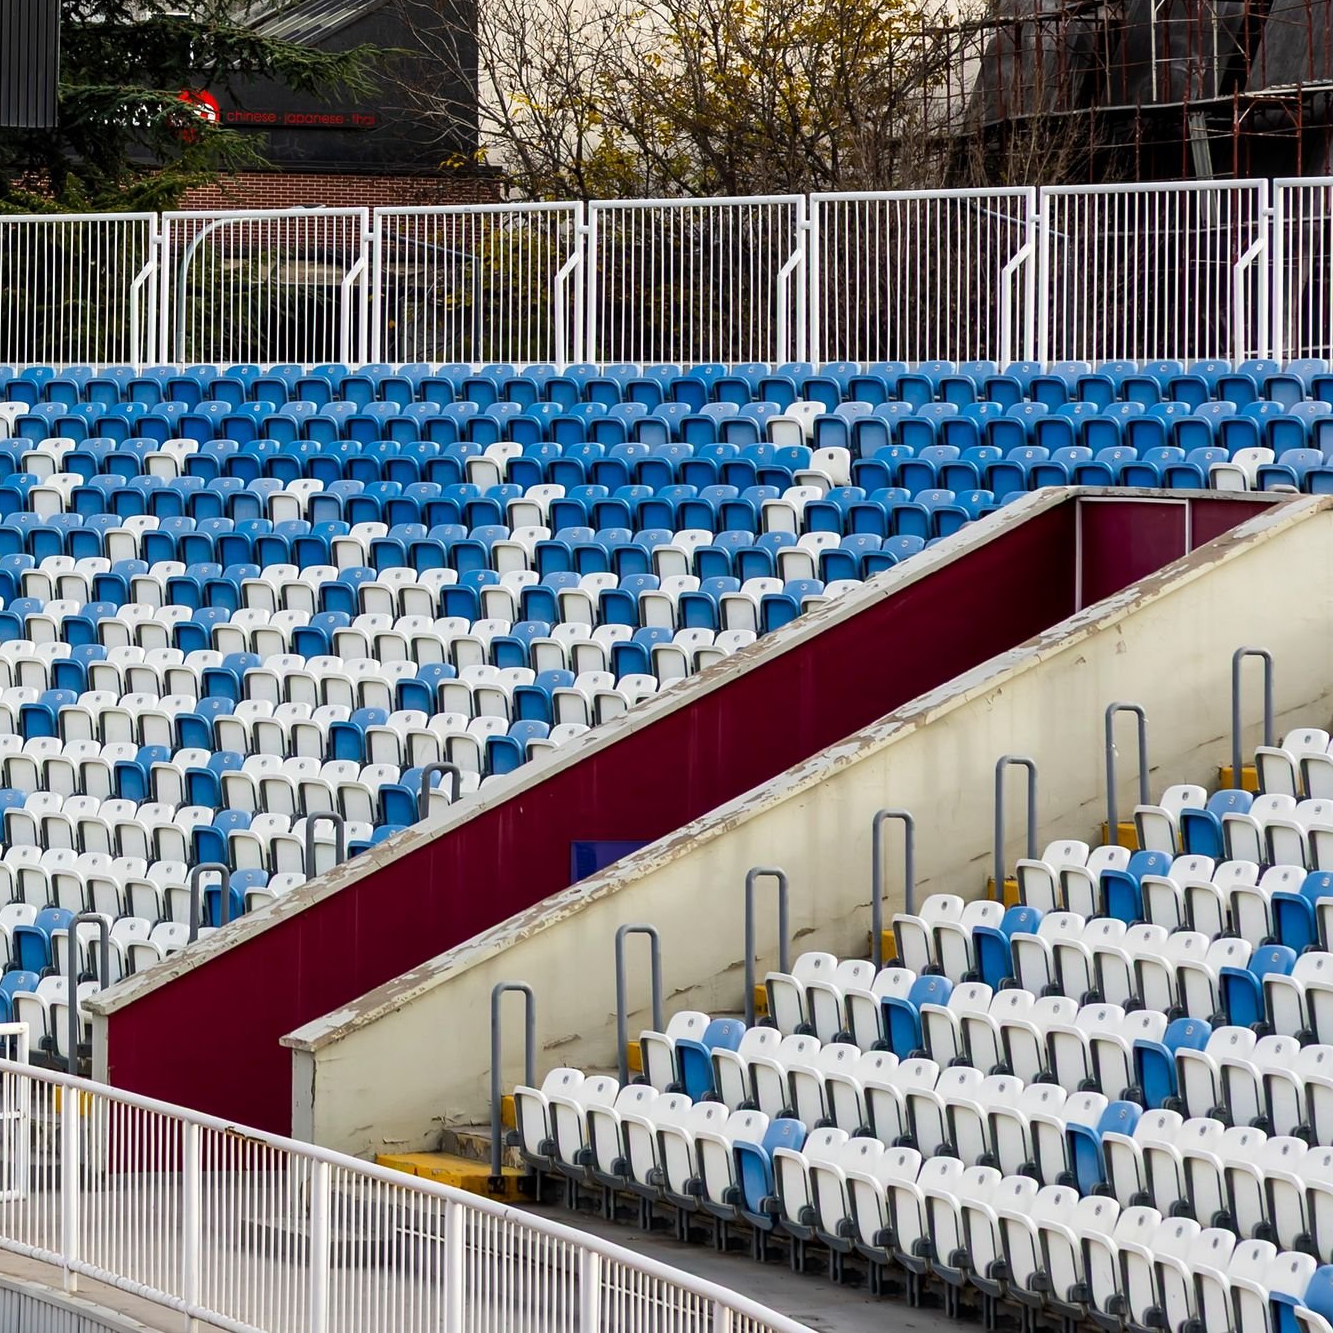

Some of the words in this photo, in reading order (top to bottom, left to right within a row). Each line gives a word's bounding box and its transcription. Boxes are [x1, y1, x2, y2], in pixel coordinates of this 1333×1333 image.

[227, 110, 276, 123] chinese
[284, 111, 343, 125] japanese
[352, 112, 375, 126] thai
